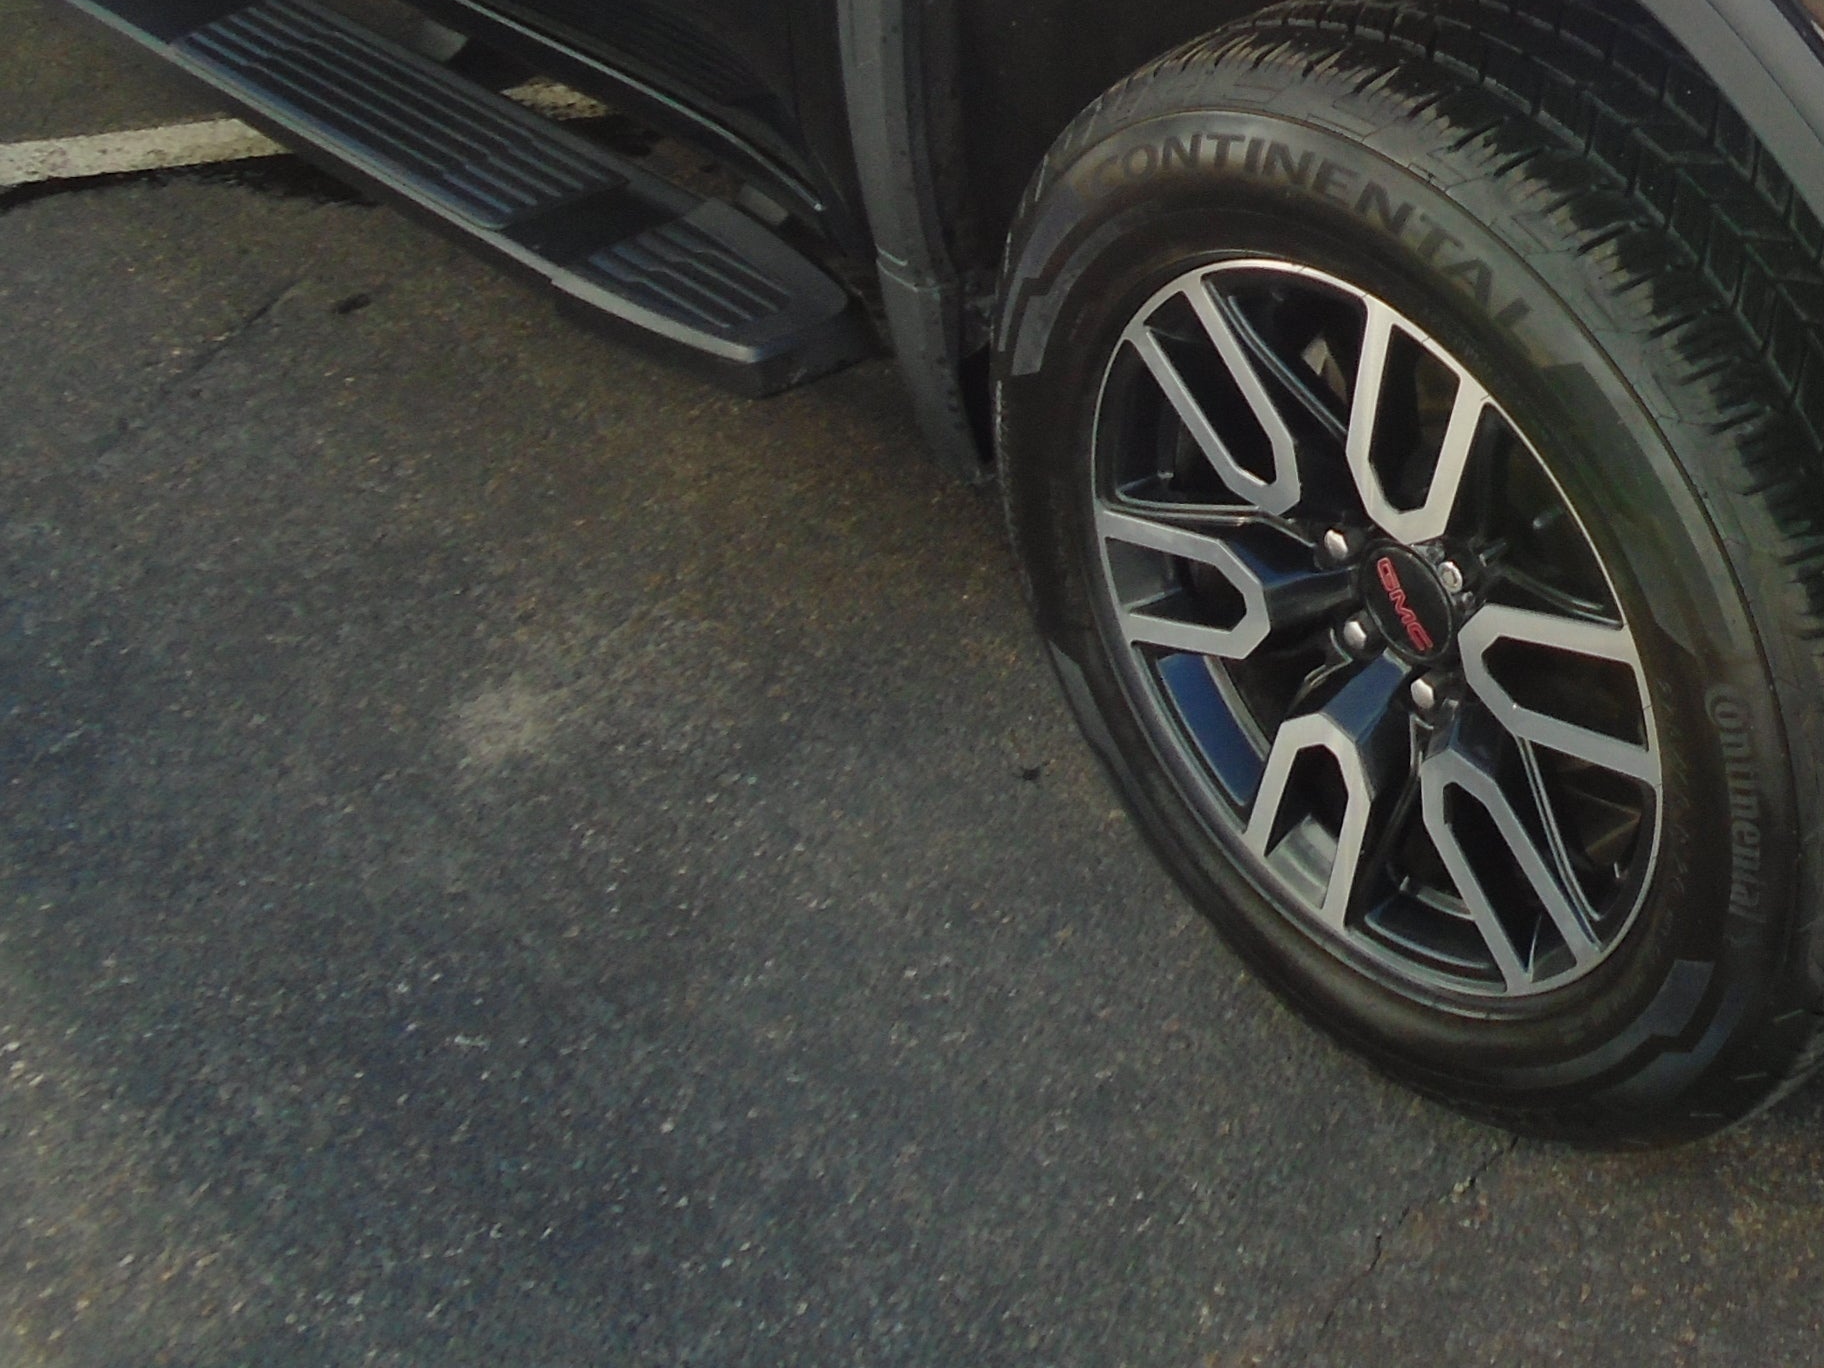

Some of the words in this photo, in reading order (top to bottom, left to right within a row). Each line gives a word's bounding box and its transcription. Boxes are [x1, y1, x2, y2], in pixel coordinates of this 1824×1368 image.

[1094, 132, 1531, 328] CONTINENTAL
[1377, 556, 1434, 651] GMC
[1705, 683, 1767, 924] Continental
